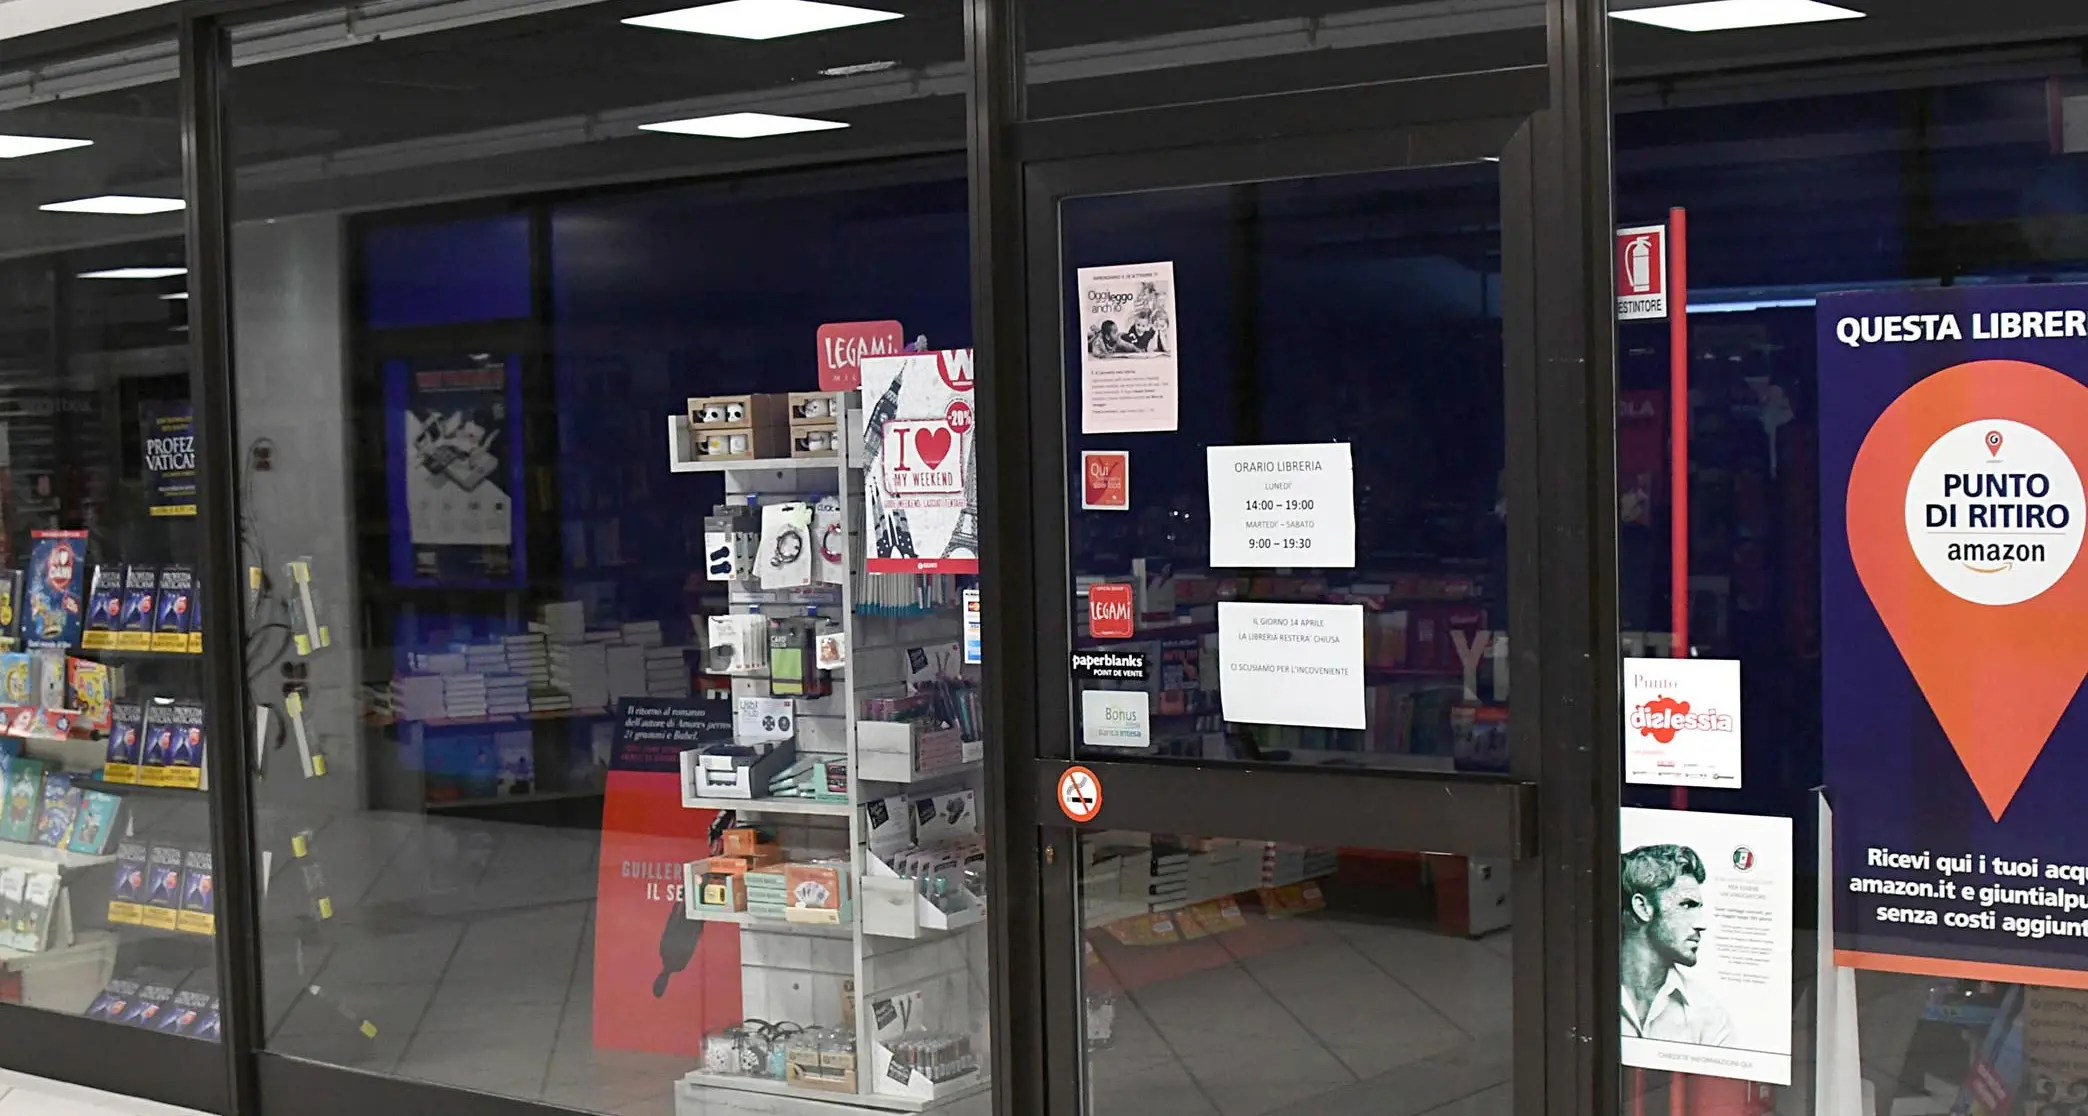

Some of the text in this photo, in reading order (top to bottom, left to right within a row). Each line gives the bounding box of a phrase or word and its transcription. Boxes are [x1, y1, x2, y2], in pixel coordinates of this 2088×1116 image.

[1088, 289, 1133, 305] Oggi leggo
[1618, 299, 1662, 314] ESTINTORE
[1836, 310, 2087, 347] QUESTA LIBRER
[941, 348, 974, 381] W
[948, 410, 972, 427] -20%
[146, 437, 195, 455] PROFEZ
[893, 428, 910, 471] I
[1090, 463, 1110, 478] Qui
[1234, 461, 1322, 473] ORARIO LIBRERIA
[893, 472, 953, 487] MY WEEKEND
[1264, 482, 1292, 490] LUNEDI'
[1944, 473, 2050, 498] PUNTO
[1245, 500, 1274, 511] 14:00
[1285, 499, 1314, 511] 19:00
[1925, 504, 2070, 528] DI RITIRO
[1245, 521, 1278, 529] MARTEDI'
[1286, 520, 1314, 529] SABATO
[1248, 538, 1271, 549] 9:00
[1283, 538, 1311, 549] 19:30
[1947, 543, 2045, 562] amazon
[1090, 601, 1131, 621] LEGAMi
[1252, 618, 1324, 628] IL GIORNO 14 APRILE
[1238, 632, 1341, 644] LA LIBRERIA RESTERA' CHIUSA
[1072, 654, 1143, 670] paperblanks
[1230, 663, 1349, 676] CI SCUSIAMO PER L'INCOVENIENTE
[1093, 668, 1112, 677] POINT
[1113, 669, 1122, 677] DE
[1633, 673, 1679, 690] Punto
[635, 706, 662, 715] ritorno
[663, 706, 671, 715] al
[1105, 707, 1137, 721] Bonus
[666, 718, 675, 728] di
[634, 731, 665, 741] grammi
[1868, 848, 2088, 886] Ricevi qui i tuoi acq
[647, 883, 683, 902] IL SE
[1850, 876, 2088, 912] amazon.it e giuntialpu
[1876, 906, 2088, 939] senza costi aggiunt
